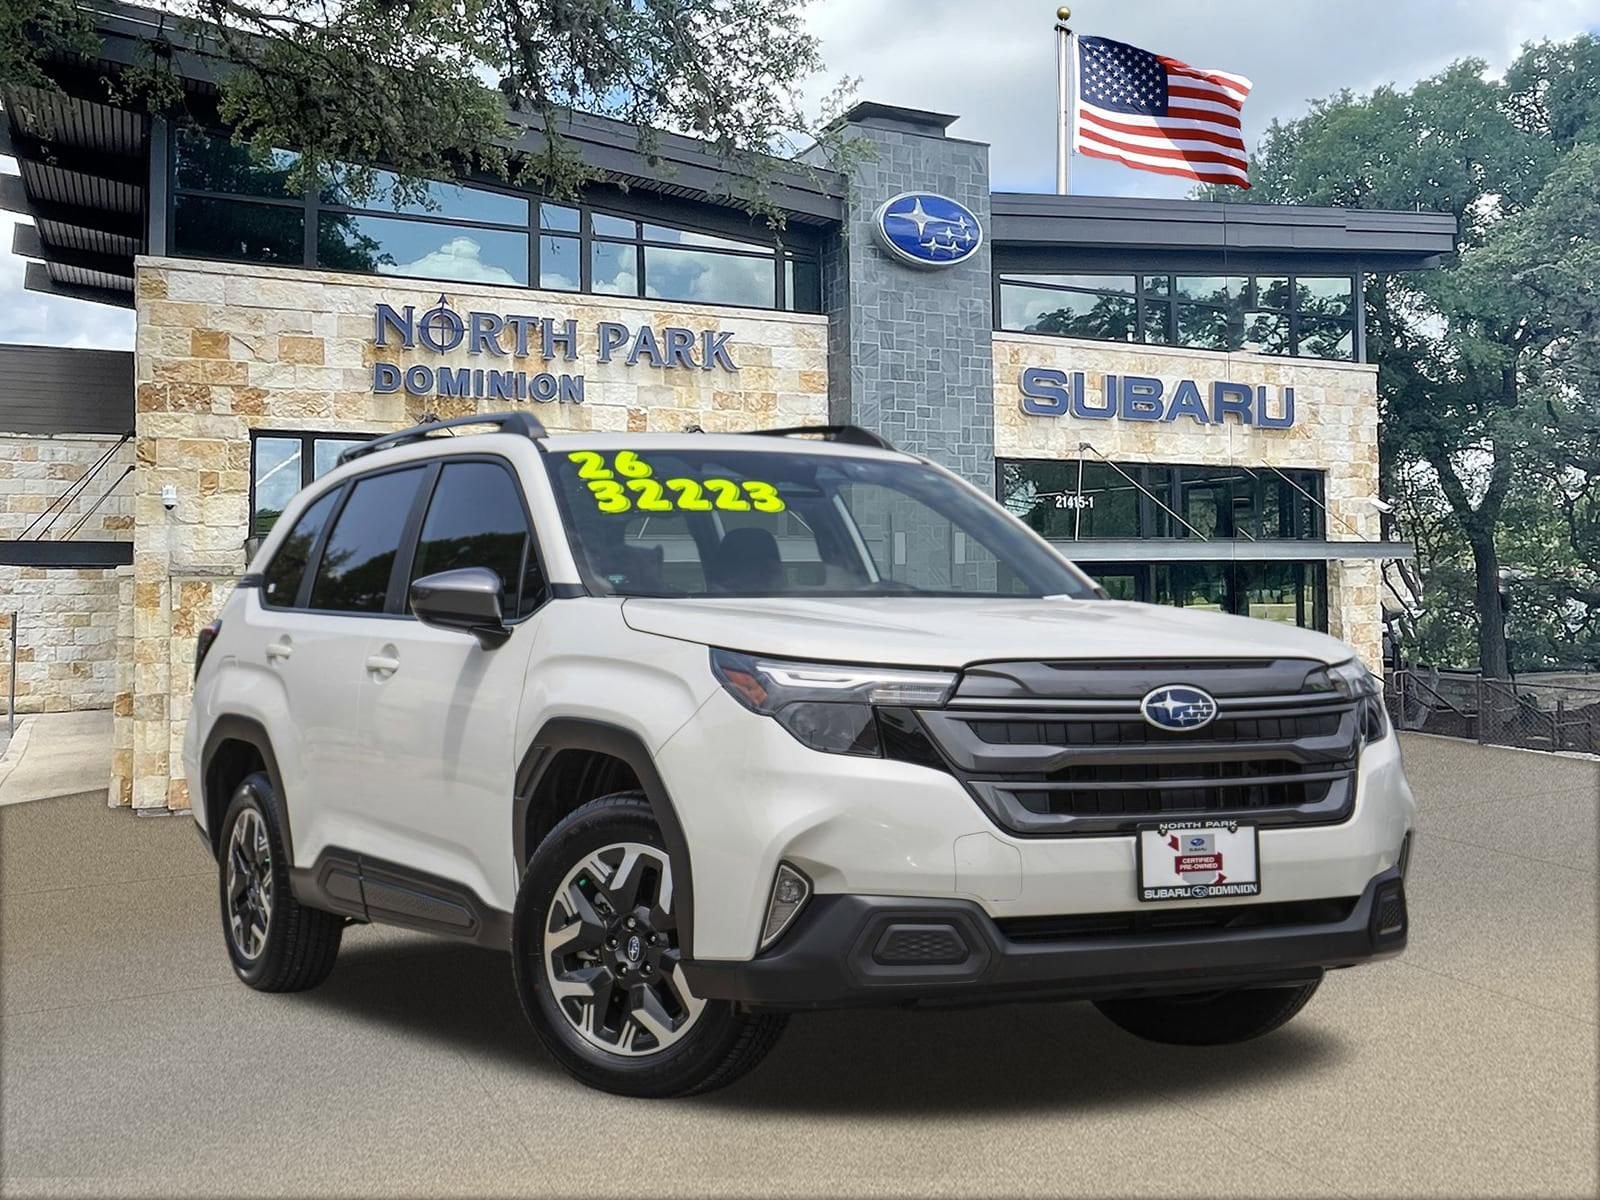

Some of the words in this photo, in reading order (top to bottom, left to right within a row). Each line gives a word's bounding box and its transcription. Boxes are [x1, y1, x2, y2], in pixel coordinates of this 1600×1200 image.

[374, 293, 579, 361] NORTH
[597, 320, 741, 373] PARK
[373, 362, 585, 404] DOMINION
[1019, 367, 1295, 429] SUBARU
[567, 450, 653, 480] 26
[587, 478, 786, 513] 32223
[1159, 822, 1201, 830] NORTH
[1205, 820, 1238, 828] PARK
[1179, 862, 1218, 870] PRE-OWNED
[1182, 856, 1215, 864] CERTIFIED
[1143, 888, 1192, 899] SUBARU
[1208, 884, 1258, 896] DOMINION
